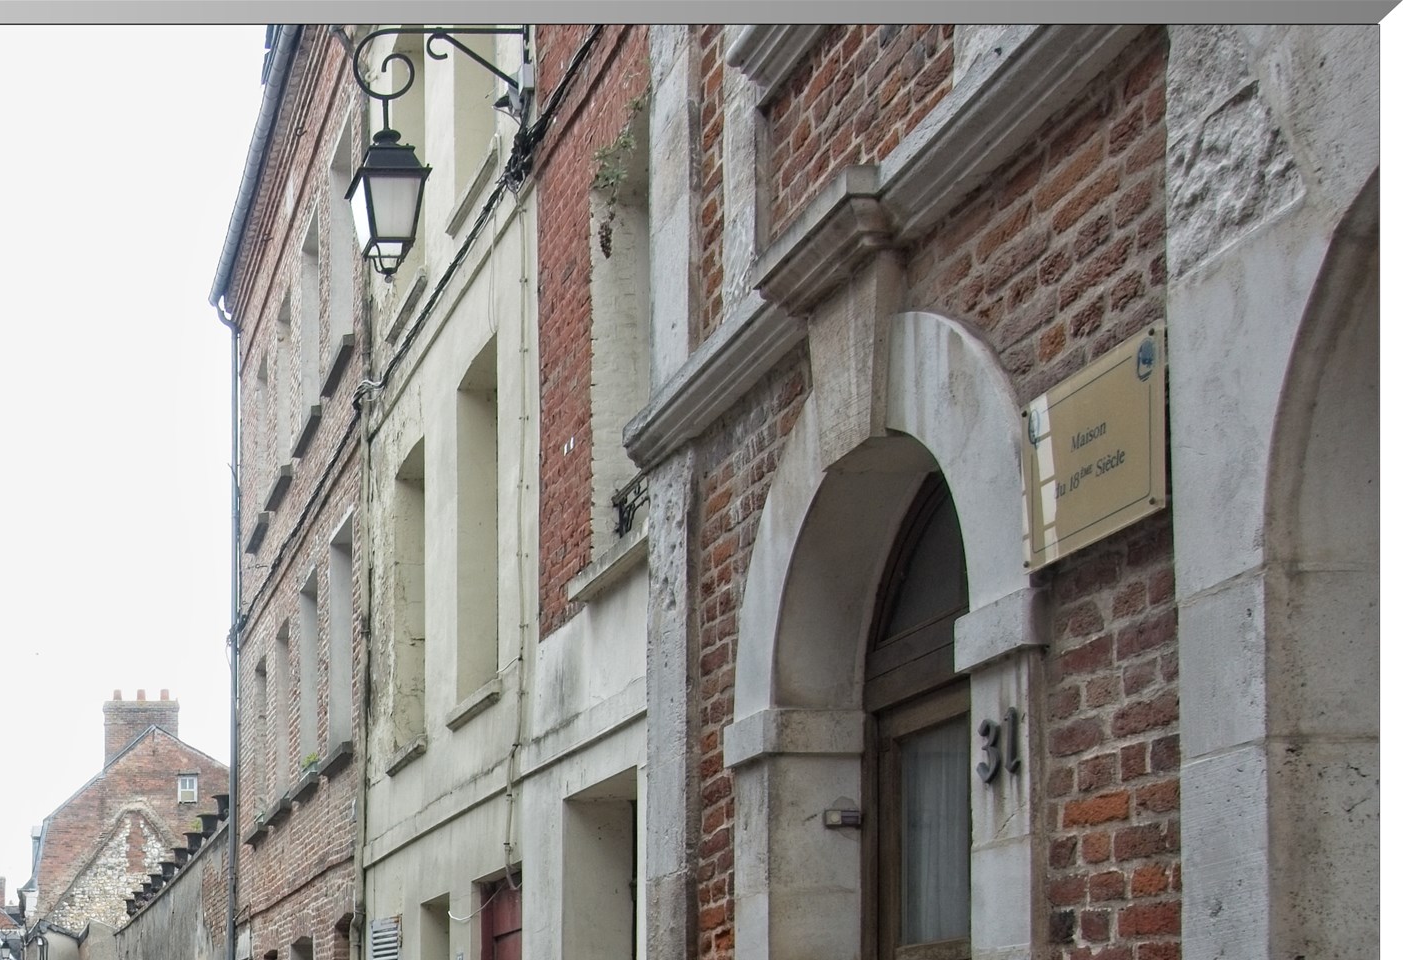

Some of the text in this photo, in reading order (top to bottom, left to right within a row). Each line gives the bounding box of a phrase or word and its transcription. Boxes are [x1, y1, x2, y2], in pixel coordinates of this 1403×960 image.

[1070, 422, 1106, 453] Maison
[1096, 449, 1126, 478] Siècle
[976, 706, 1021, 784] 31
